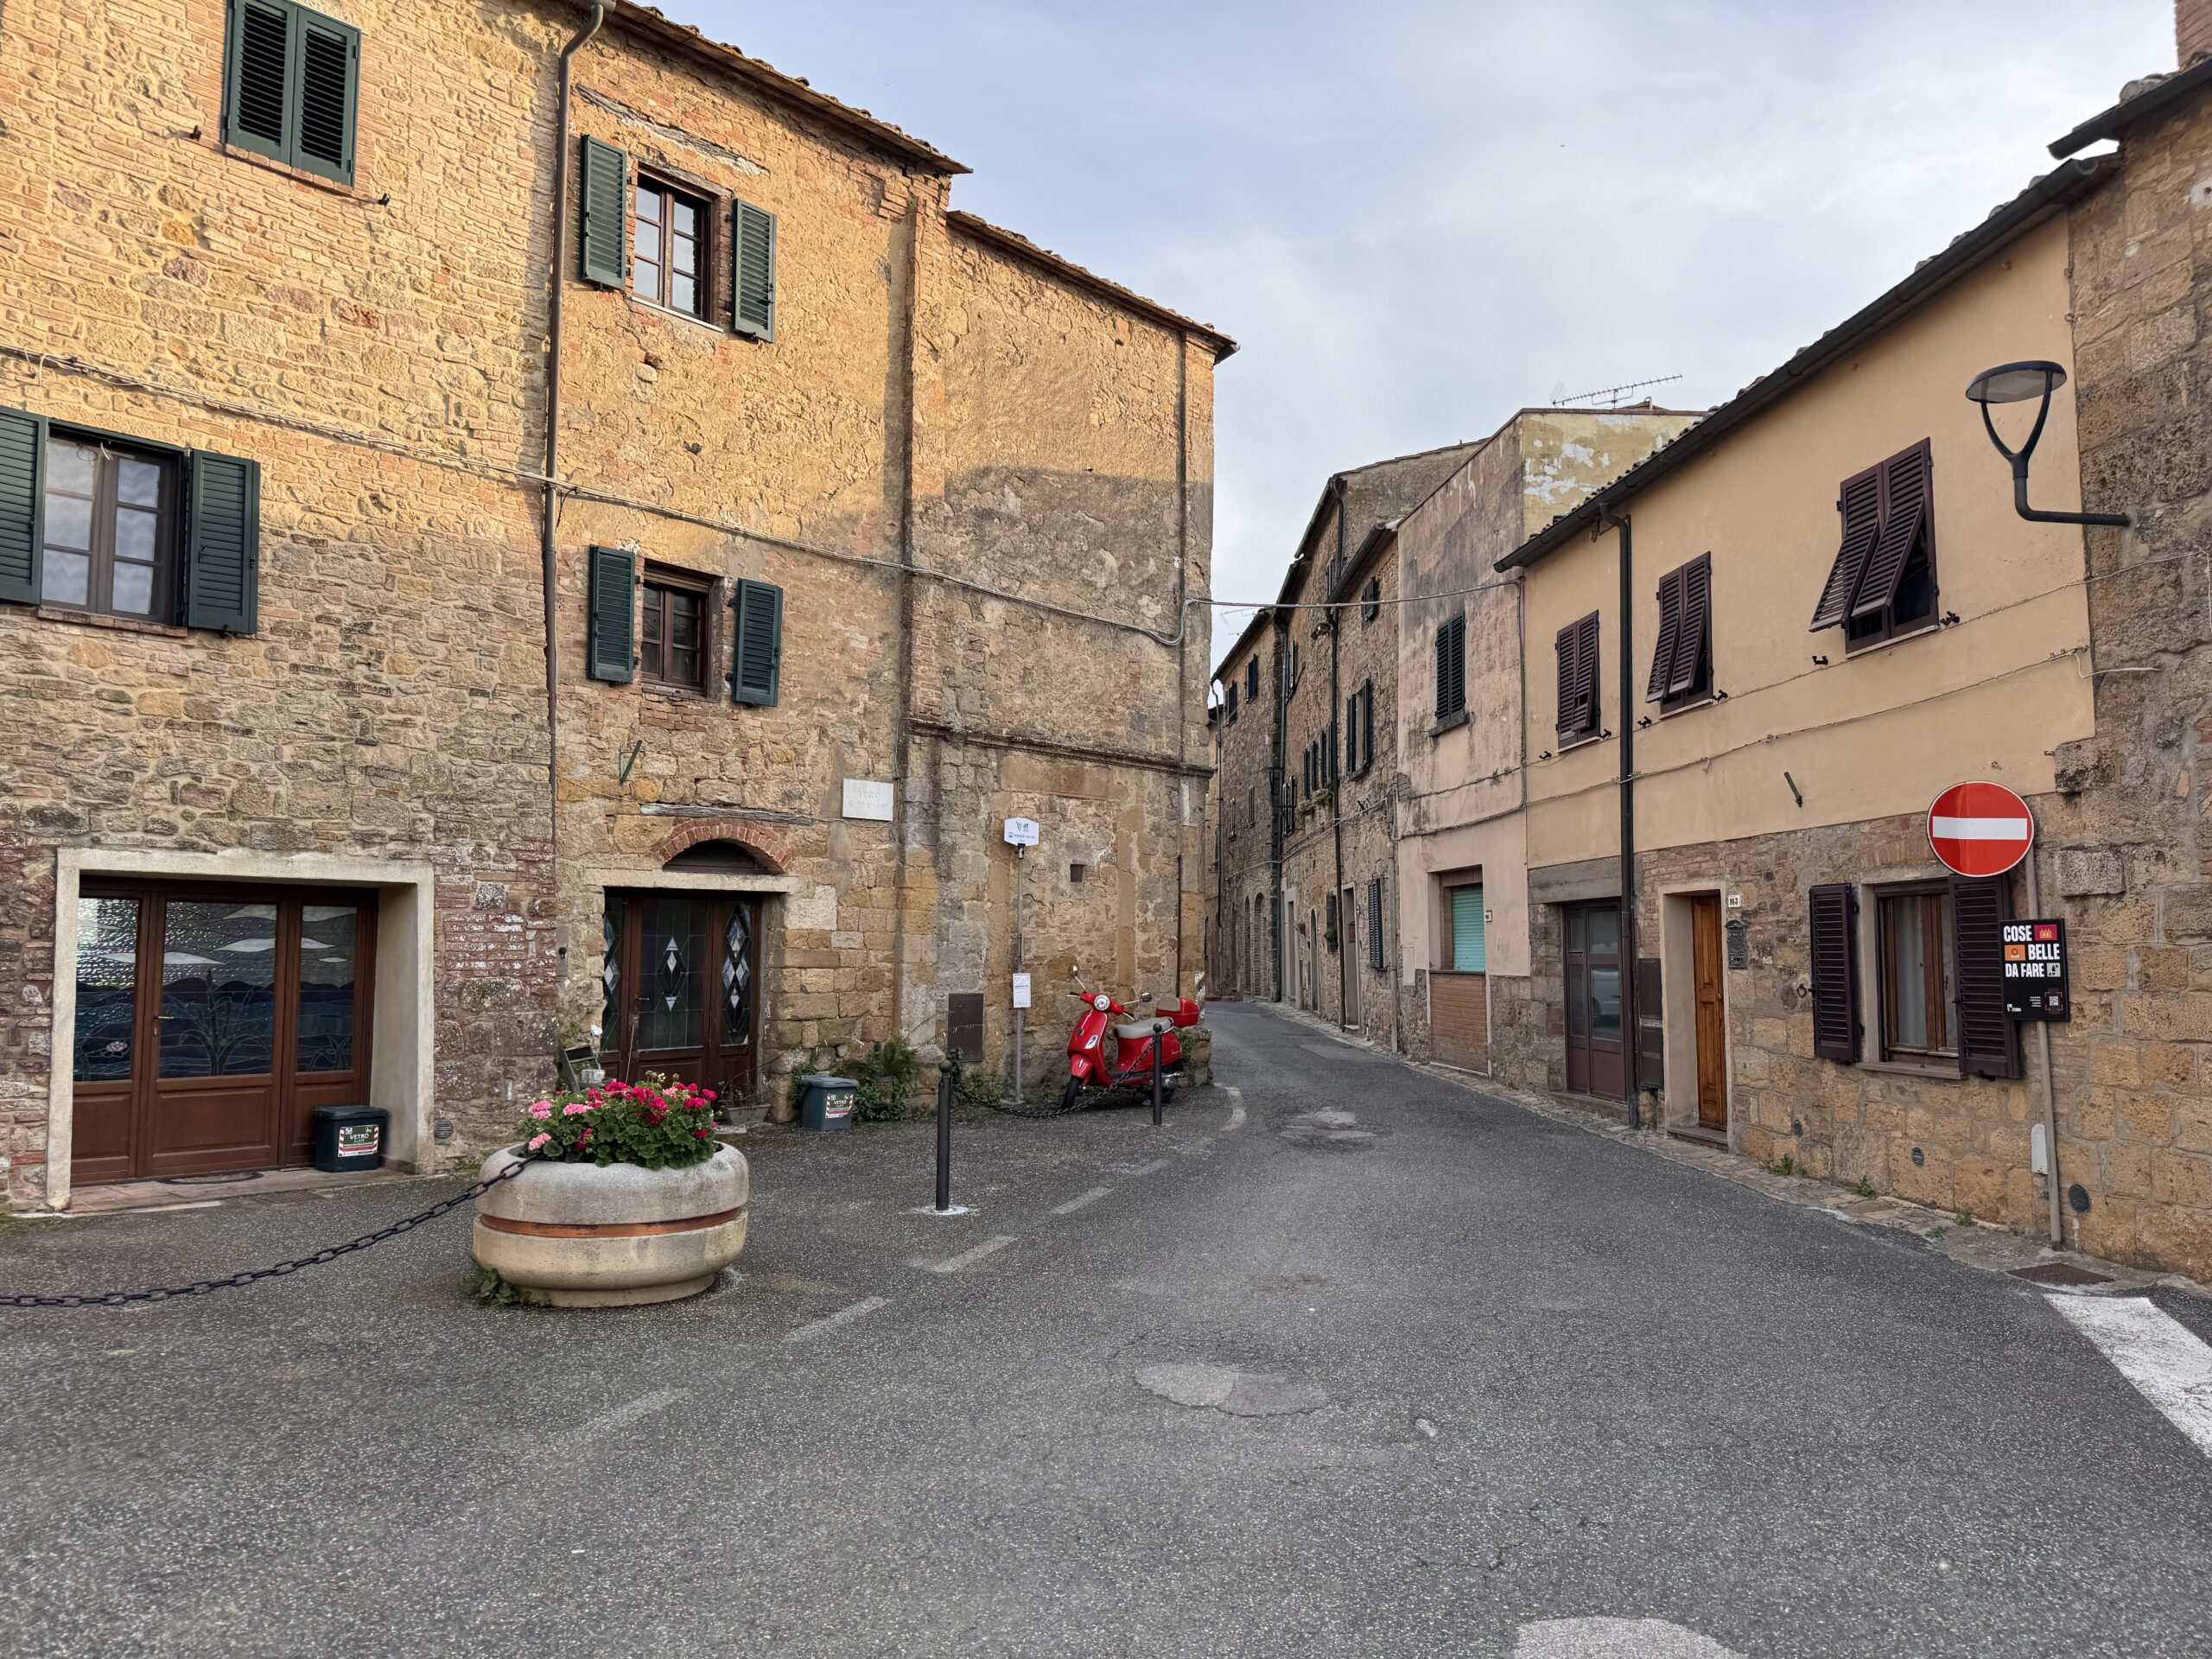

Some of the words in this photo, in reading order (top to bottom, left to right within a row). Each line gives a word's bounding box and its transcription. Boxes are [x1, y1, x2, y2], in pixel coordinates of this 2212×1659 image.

[2003, 925, 2032, 942] COSE
[2027, 943, 2061, 961] BELLE
[2005, 963, 2019, 978] DA
[2020, 963, 2045, 978] FARE
